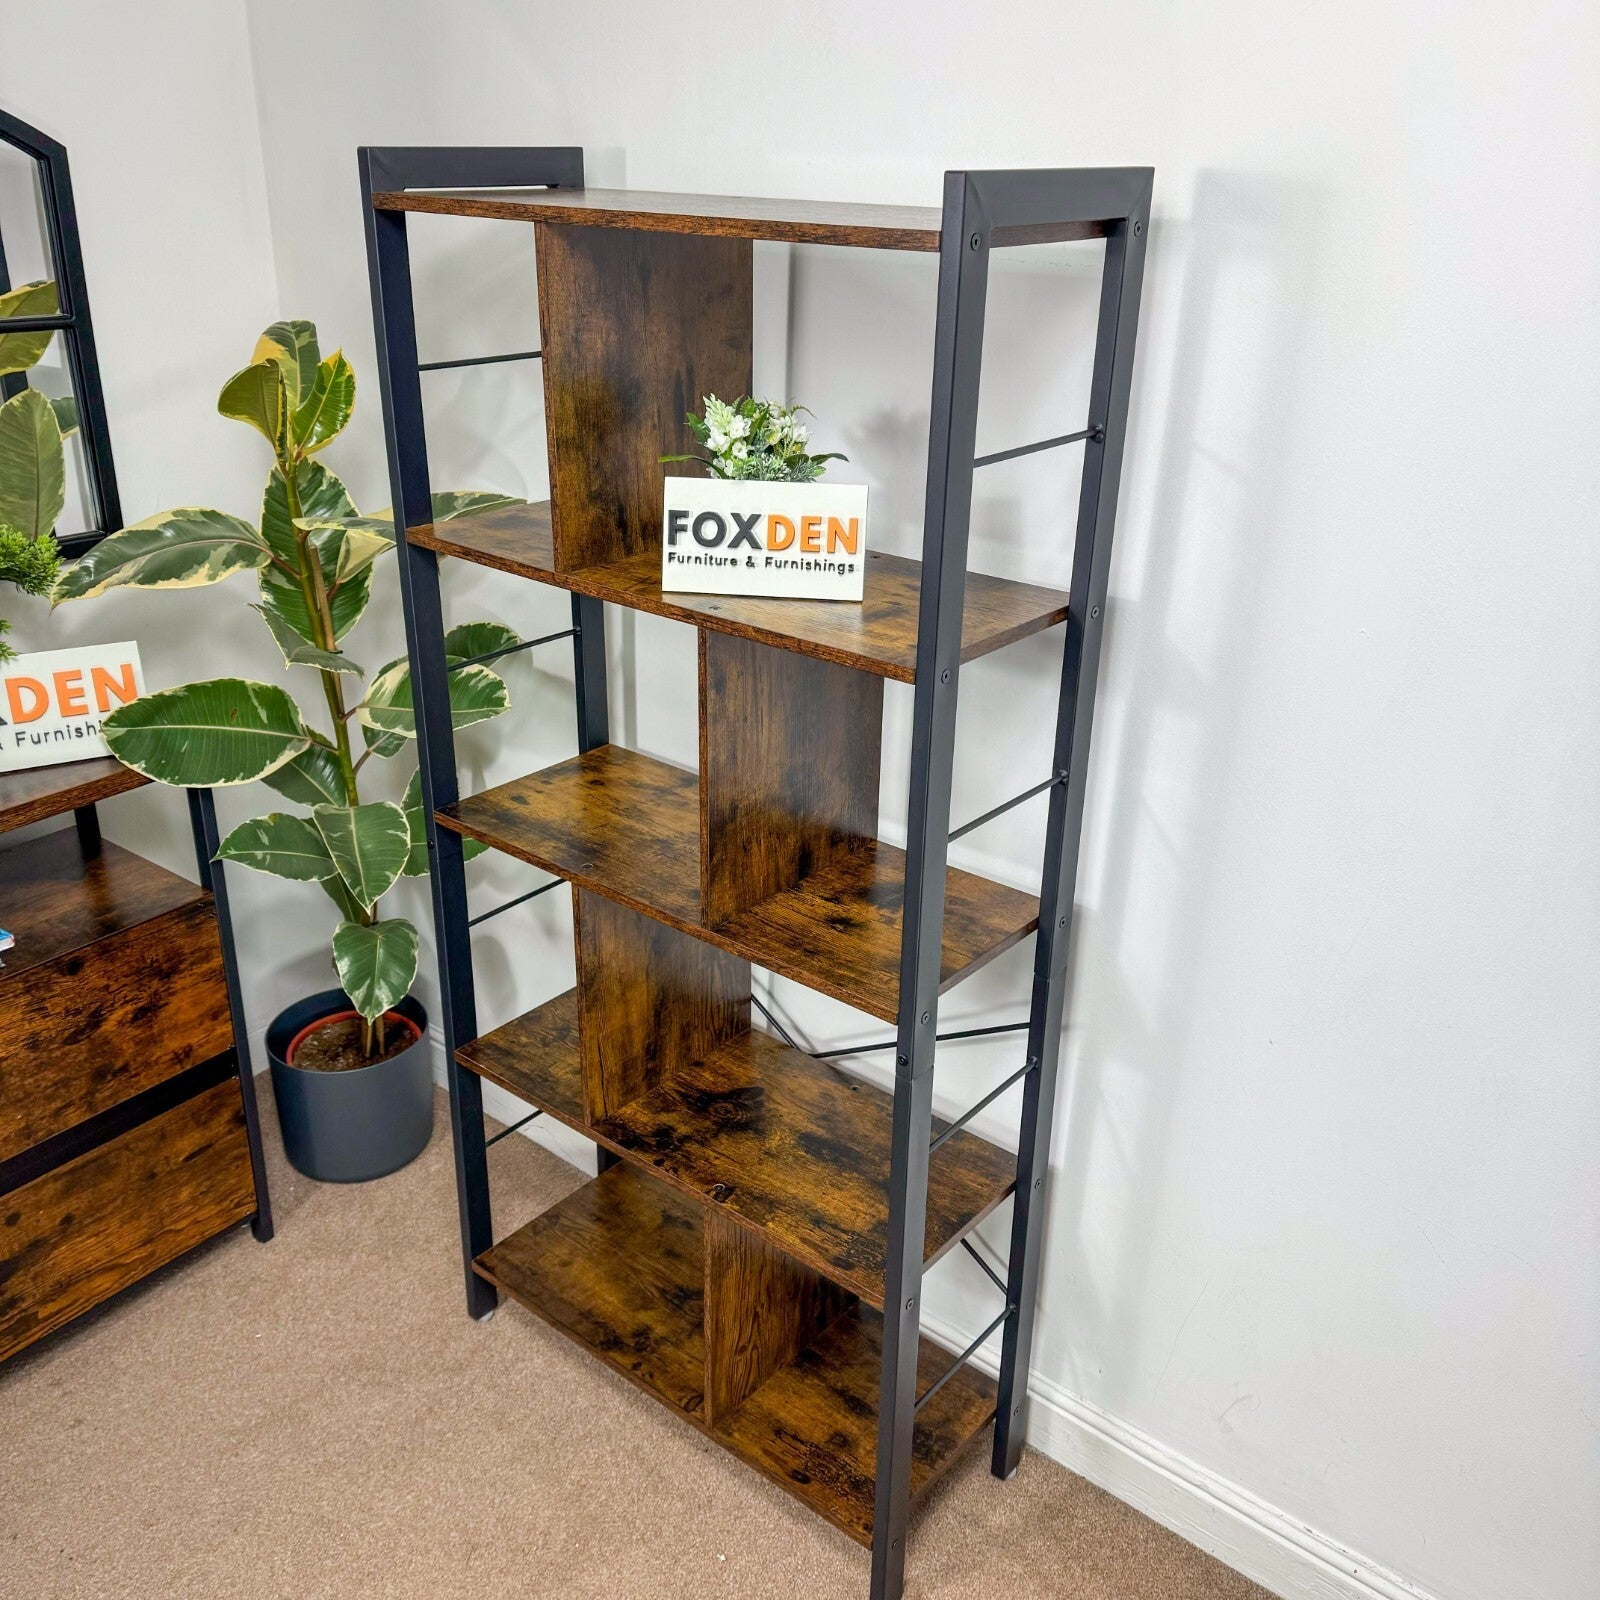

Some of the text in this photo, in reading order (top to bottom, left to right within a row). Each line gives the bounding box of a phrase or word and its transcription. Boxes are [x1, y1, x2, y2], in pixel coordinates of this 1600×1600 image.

[667, 509, 859, 555] FOXDEN
[667, 552, 856, 575] Furniture & Furnishings
[0, 663, 138, 726] DEN
